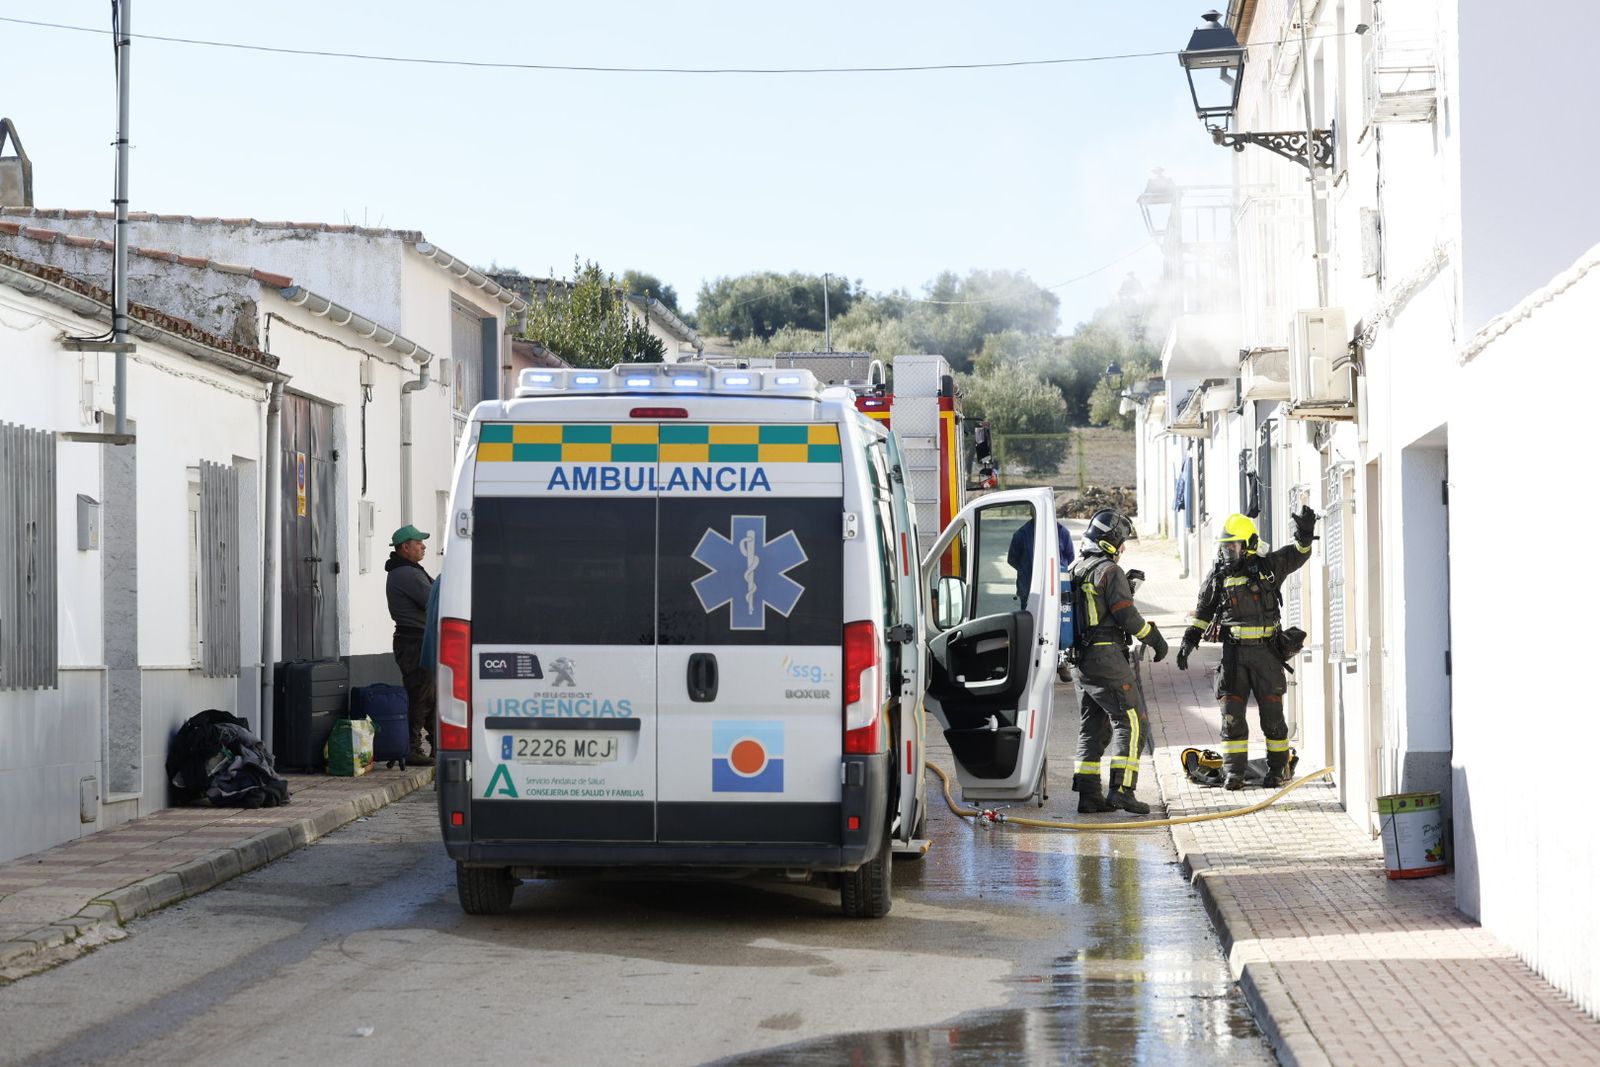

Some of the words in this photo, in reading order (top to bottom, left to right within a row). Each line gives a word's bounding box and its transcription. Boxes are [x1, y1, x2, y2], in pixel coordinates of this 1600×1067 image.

[547, 466, 772, 492] AMBULANCIA
[484, 660, 507, 669] OCA
[533, 691, 593, 699] PEUGEOT
[785, 688, 831, 700] BOXER
[487, 699, 632, 718] URGENCIAS
[517, 739, 566, 757] 2226
[574, 740, 611, 757] MCJ
[526, 777, 550, 785] Servicio
[551, 777, 577, 785] Andaluz
[578, 777, 587, 785] de
[588, 777, 606, 785] Salud
[570, 788, 580, 797] DE
[581, 789, 605, 797] SALUD
[606, 789, 611, 797] Y
[612, 789, 645, 798] FAMILIAS
